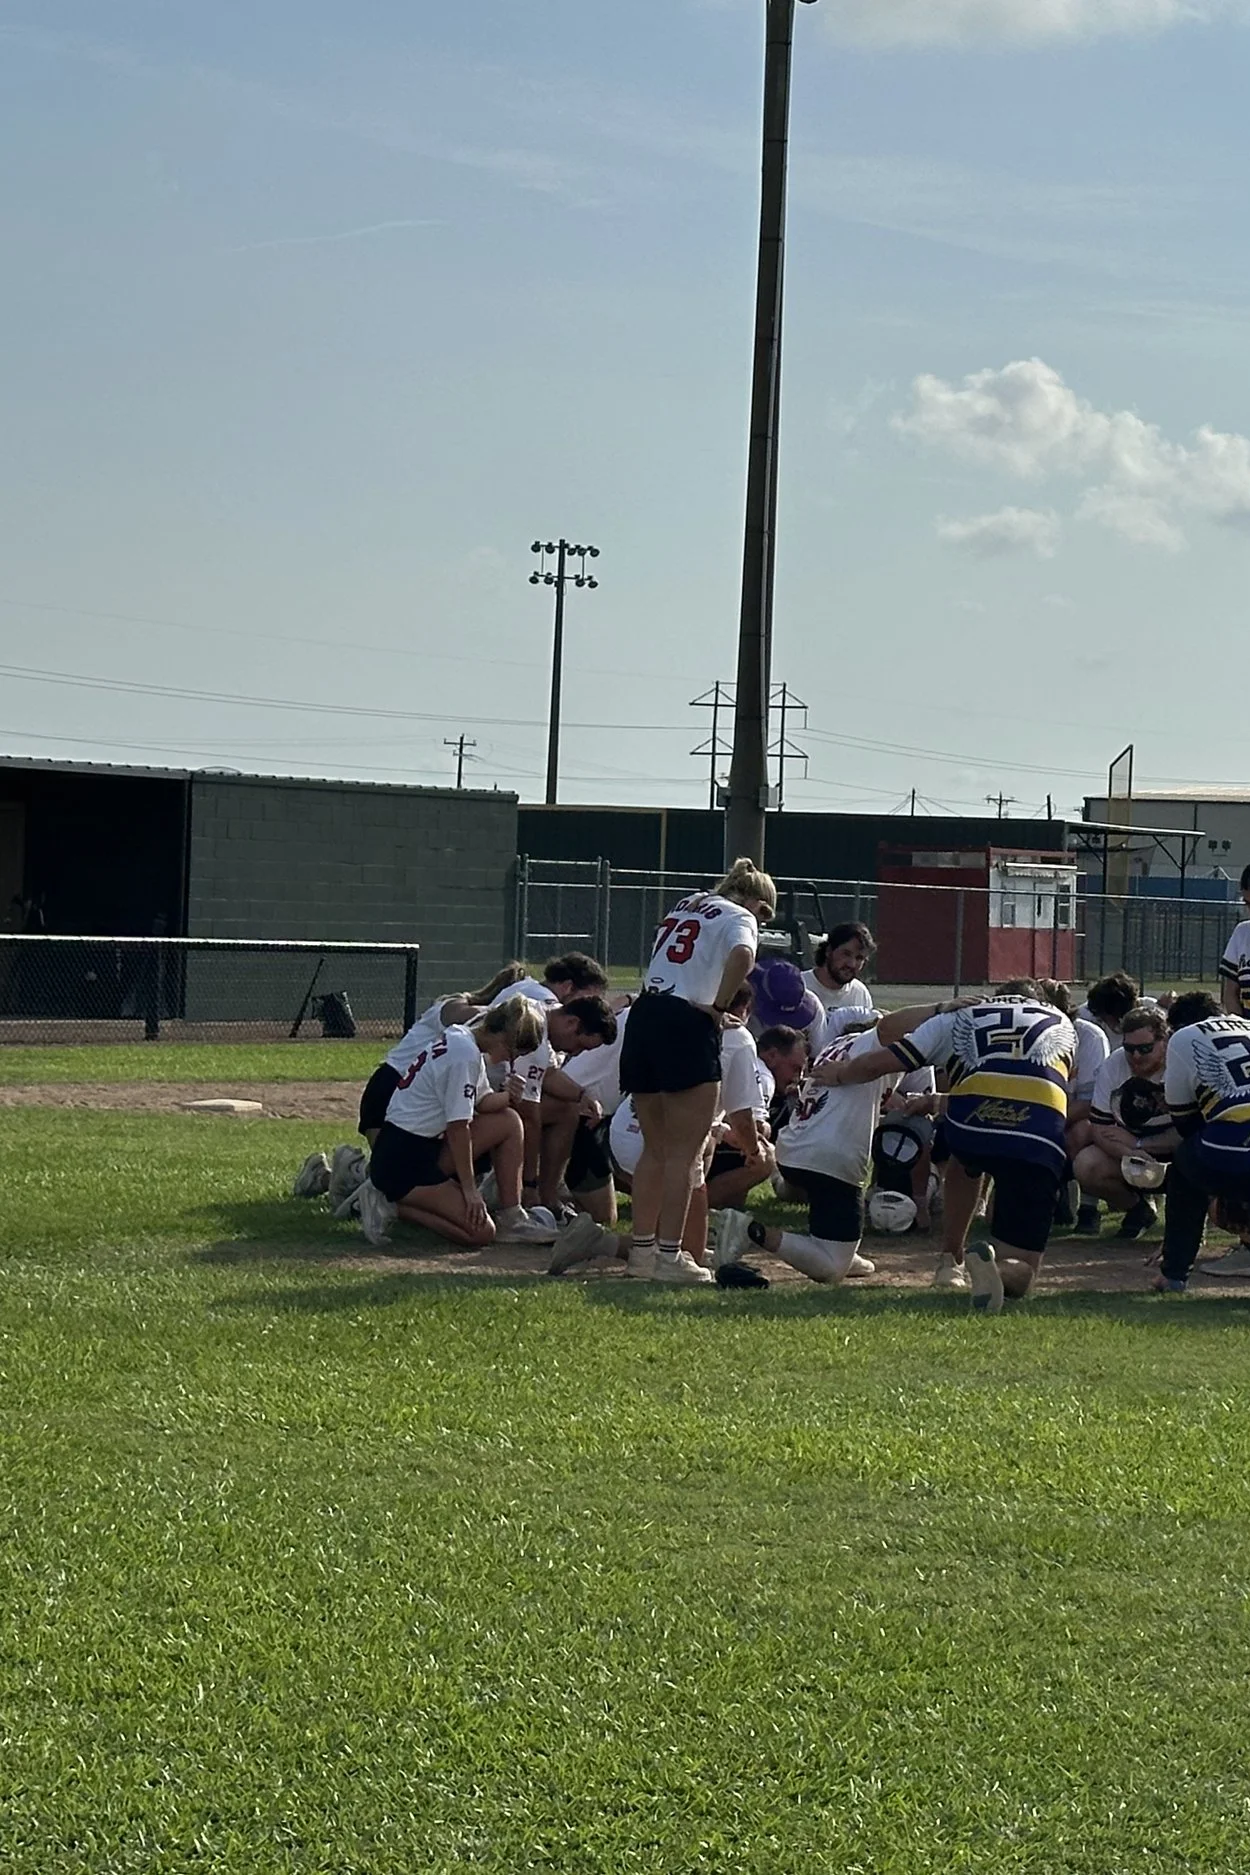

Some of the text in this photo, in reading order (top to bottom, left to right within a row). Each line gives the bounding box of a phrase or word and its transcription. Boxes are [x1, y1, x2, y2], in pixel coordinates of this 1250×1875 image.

[652, 918, 701, 964] 73
[972, 1007, 1062, 1058] 27
[528, 1065, 545, 1081] 27
